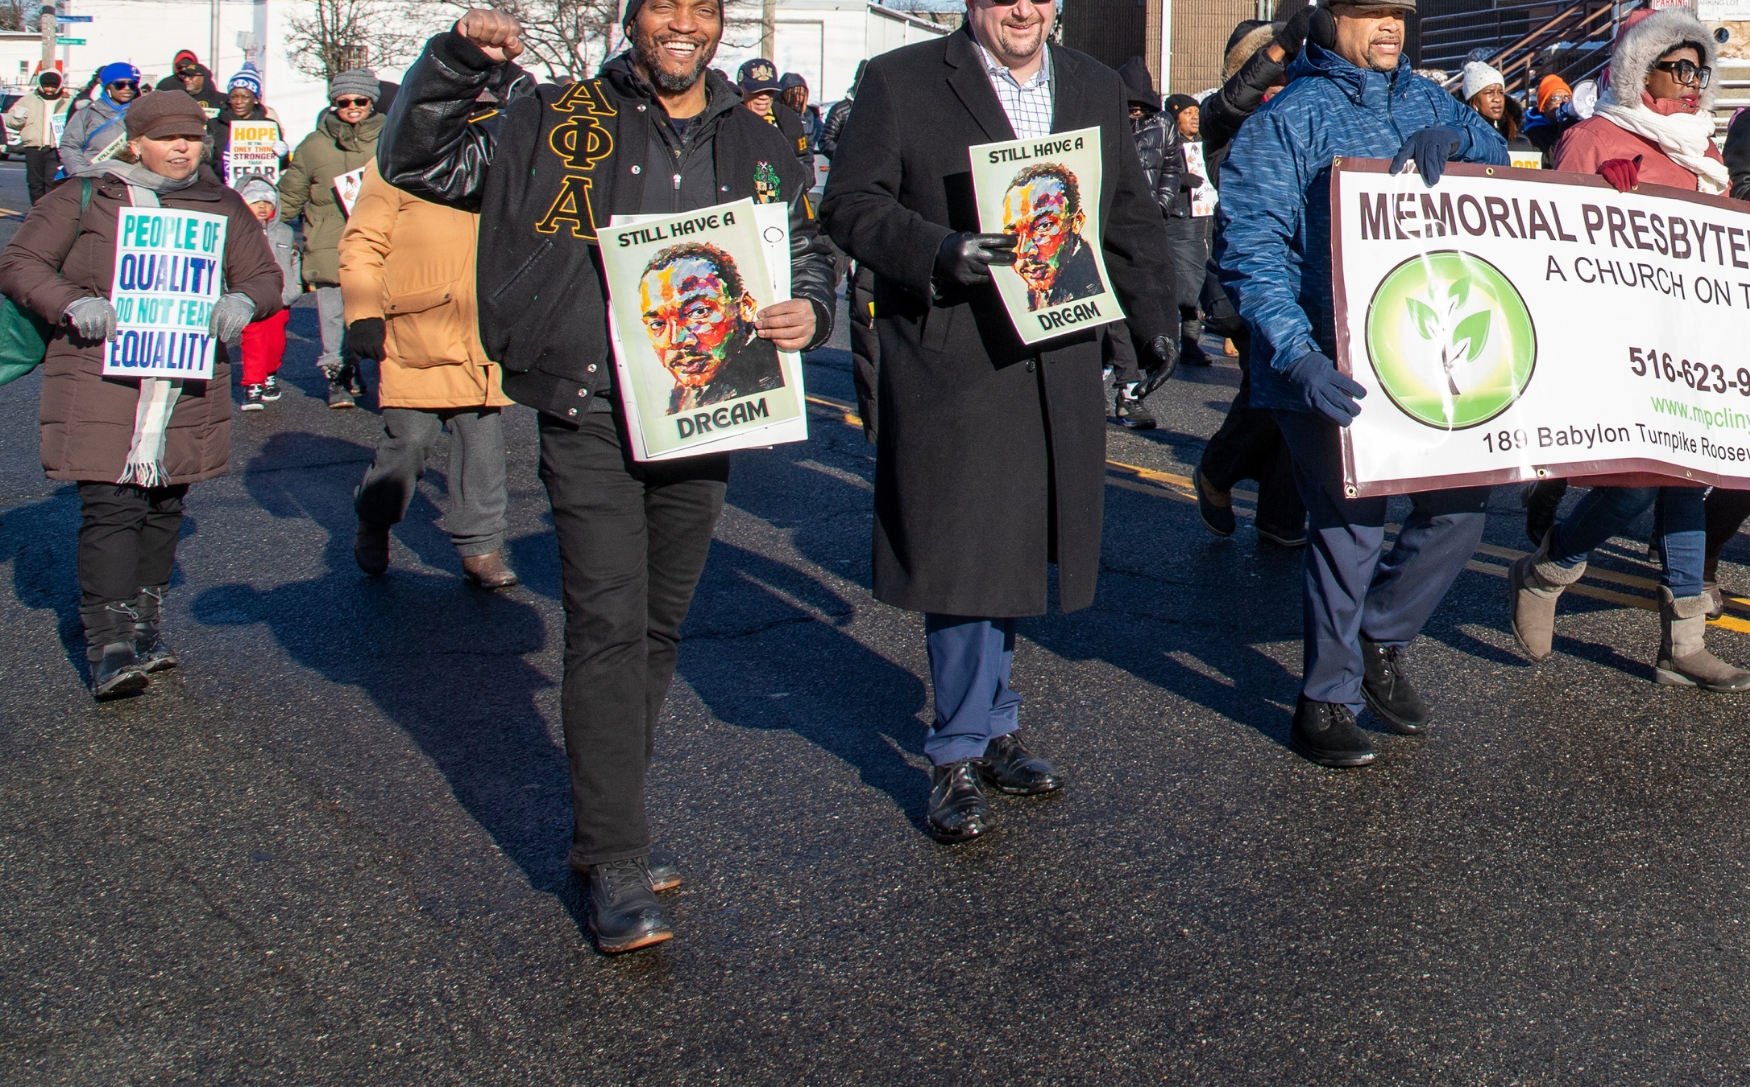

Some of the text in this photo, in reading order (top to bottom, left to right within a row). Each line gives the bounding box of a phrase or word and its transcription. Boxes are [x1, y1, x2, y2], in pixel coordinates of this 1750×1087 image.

[234, 127, 277, 141] HOPE
[989, 136, 1084, 164] STILL HAVE A
[233, 166, 276, 180] FEAR
[123, 214, 221, 253] PEOPLE OF
[618, 211, 736, 247] STILL HAVE A
[1359, 191, 1578, 243] MEMORIAL
[119, 253, 217, 296] QUALITY
[1545, 255, 1568, 283] A
[1573, 256, 1686, 300] CHURCH
[1694, 276, 1732, 307] ON
[116, 297, 213, 327] DO NOT FEAR
[1037, 300, 1102, 332] DREAM
[110, 330, 211, 371] EQUALITY
[676, 397, 770, 440] DREAM
[1482, 429, 1528, 453] 189
[1537, 423, 1631, 449] Babylon
[1635, 422, 1698, 453] Turnpike
